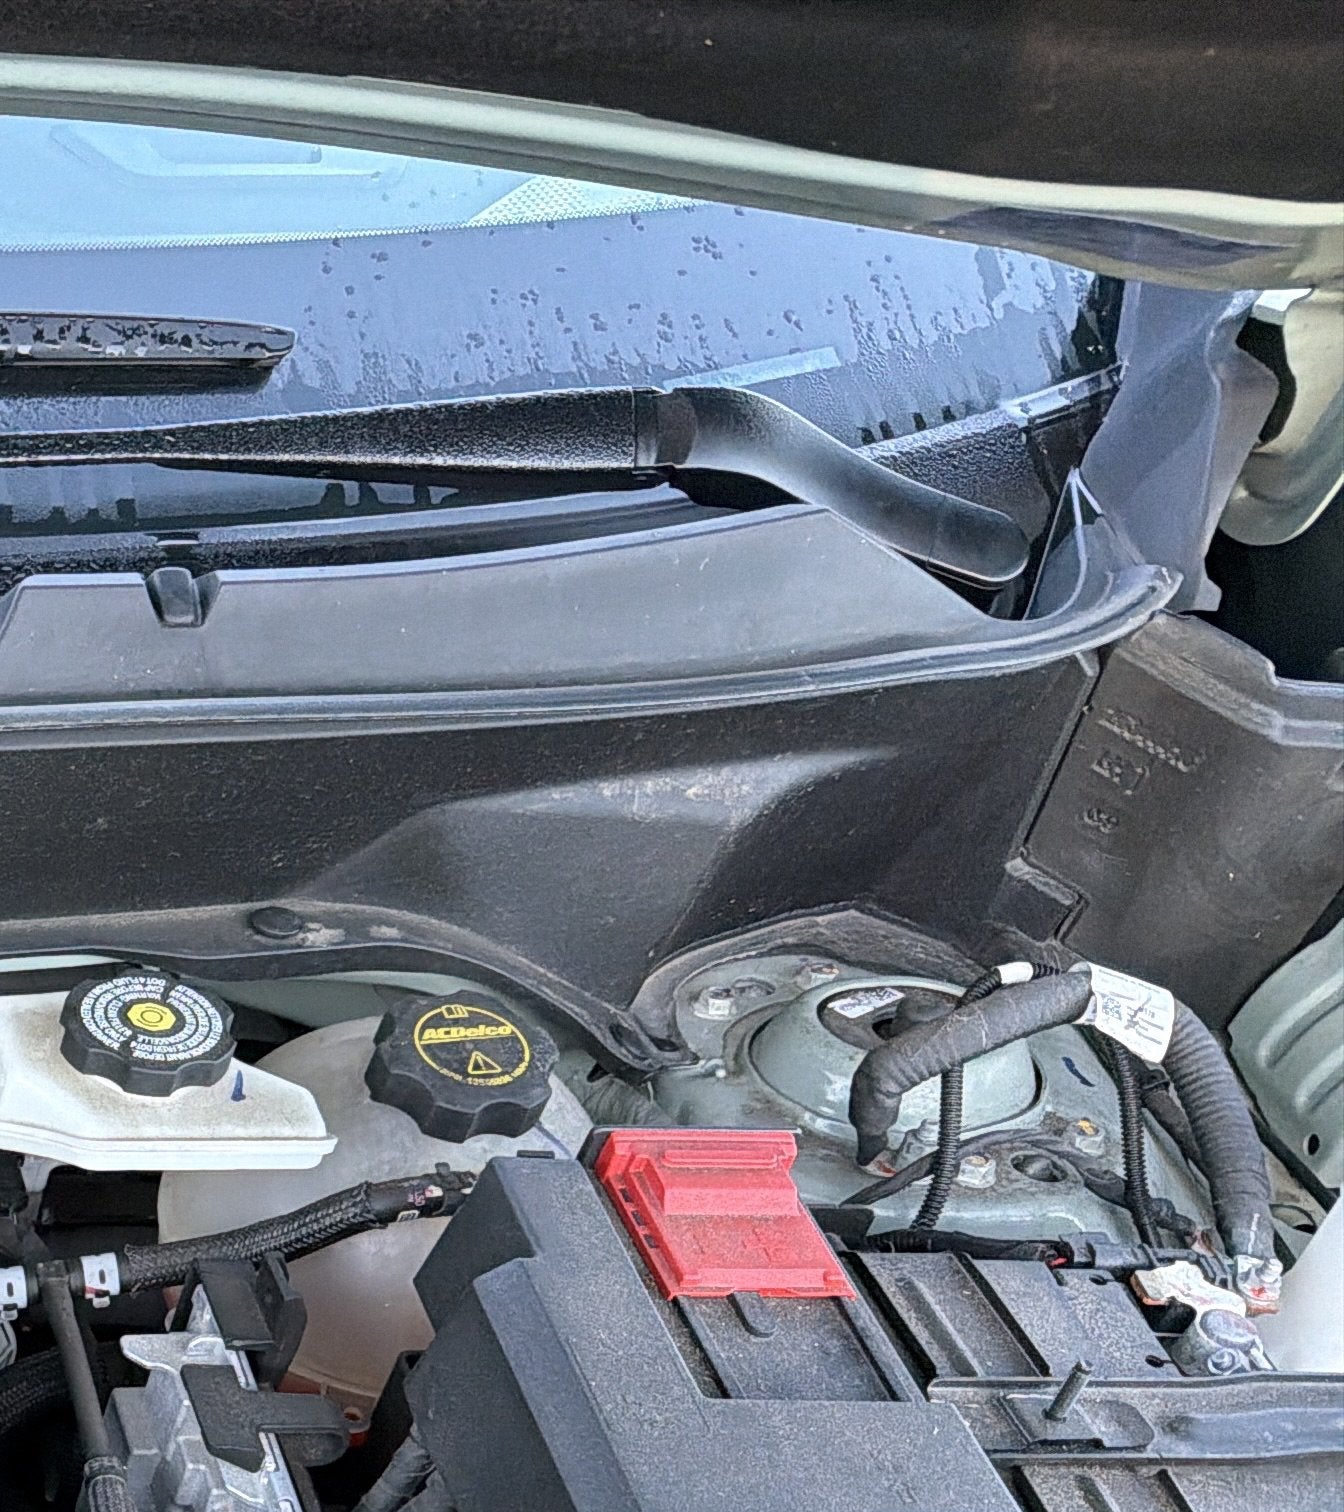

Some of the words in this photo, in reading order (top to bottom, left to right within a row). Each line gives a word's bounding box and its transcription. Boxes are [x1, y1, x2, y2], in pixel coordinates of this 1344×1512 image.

[112, 976, 139, 986] FLUID
[138, 976, 146, 984] 4
[145, 977, 166, 987] DOT
[143, 984, 164, 993] CAP
[422, 1024, 512, 1040] ACDelco
